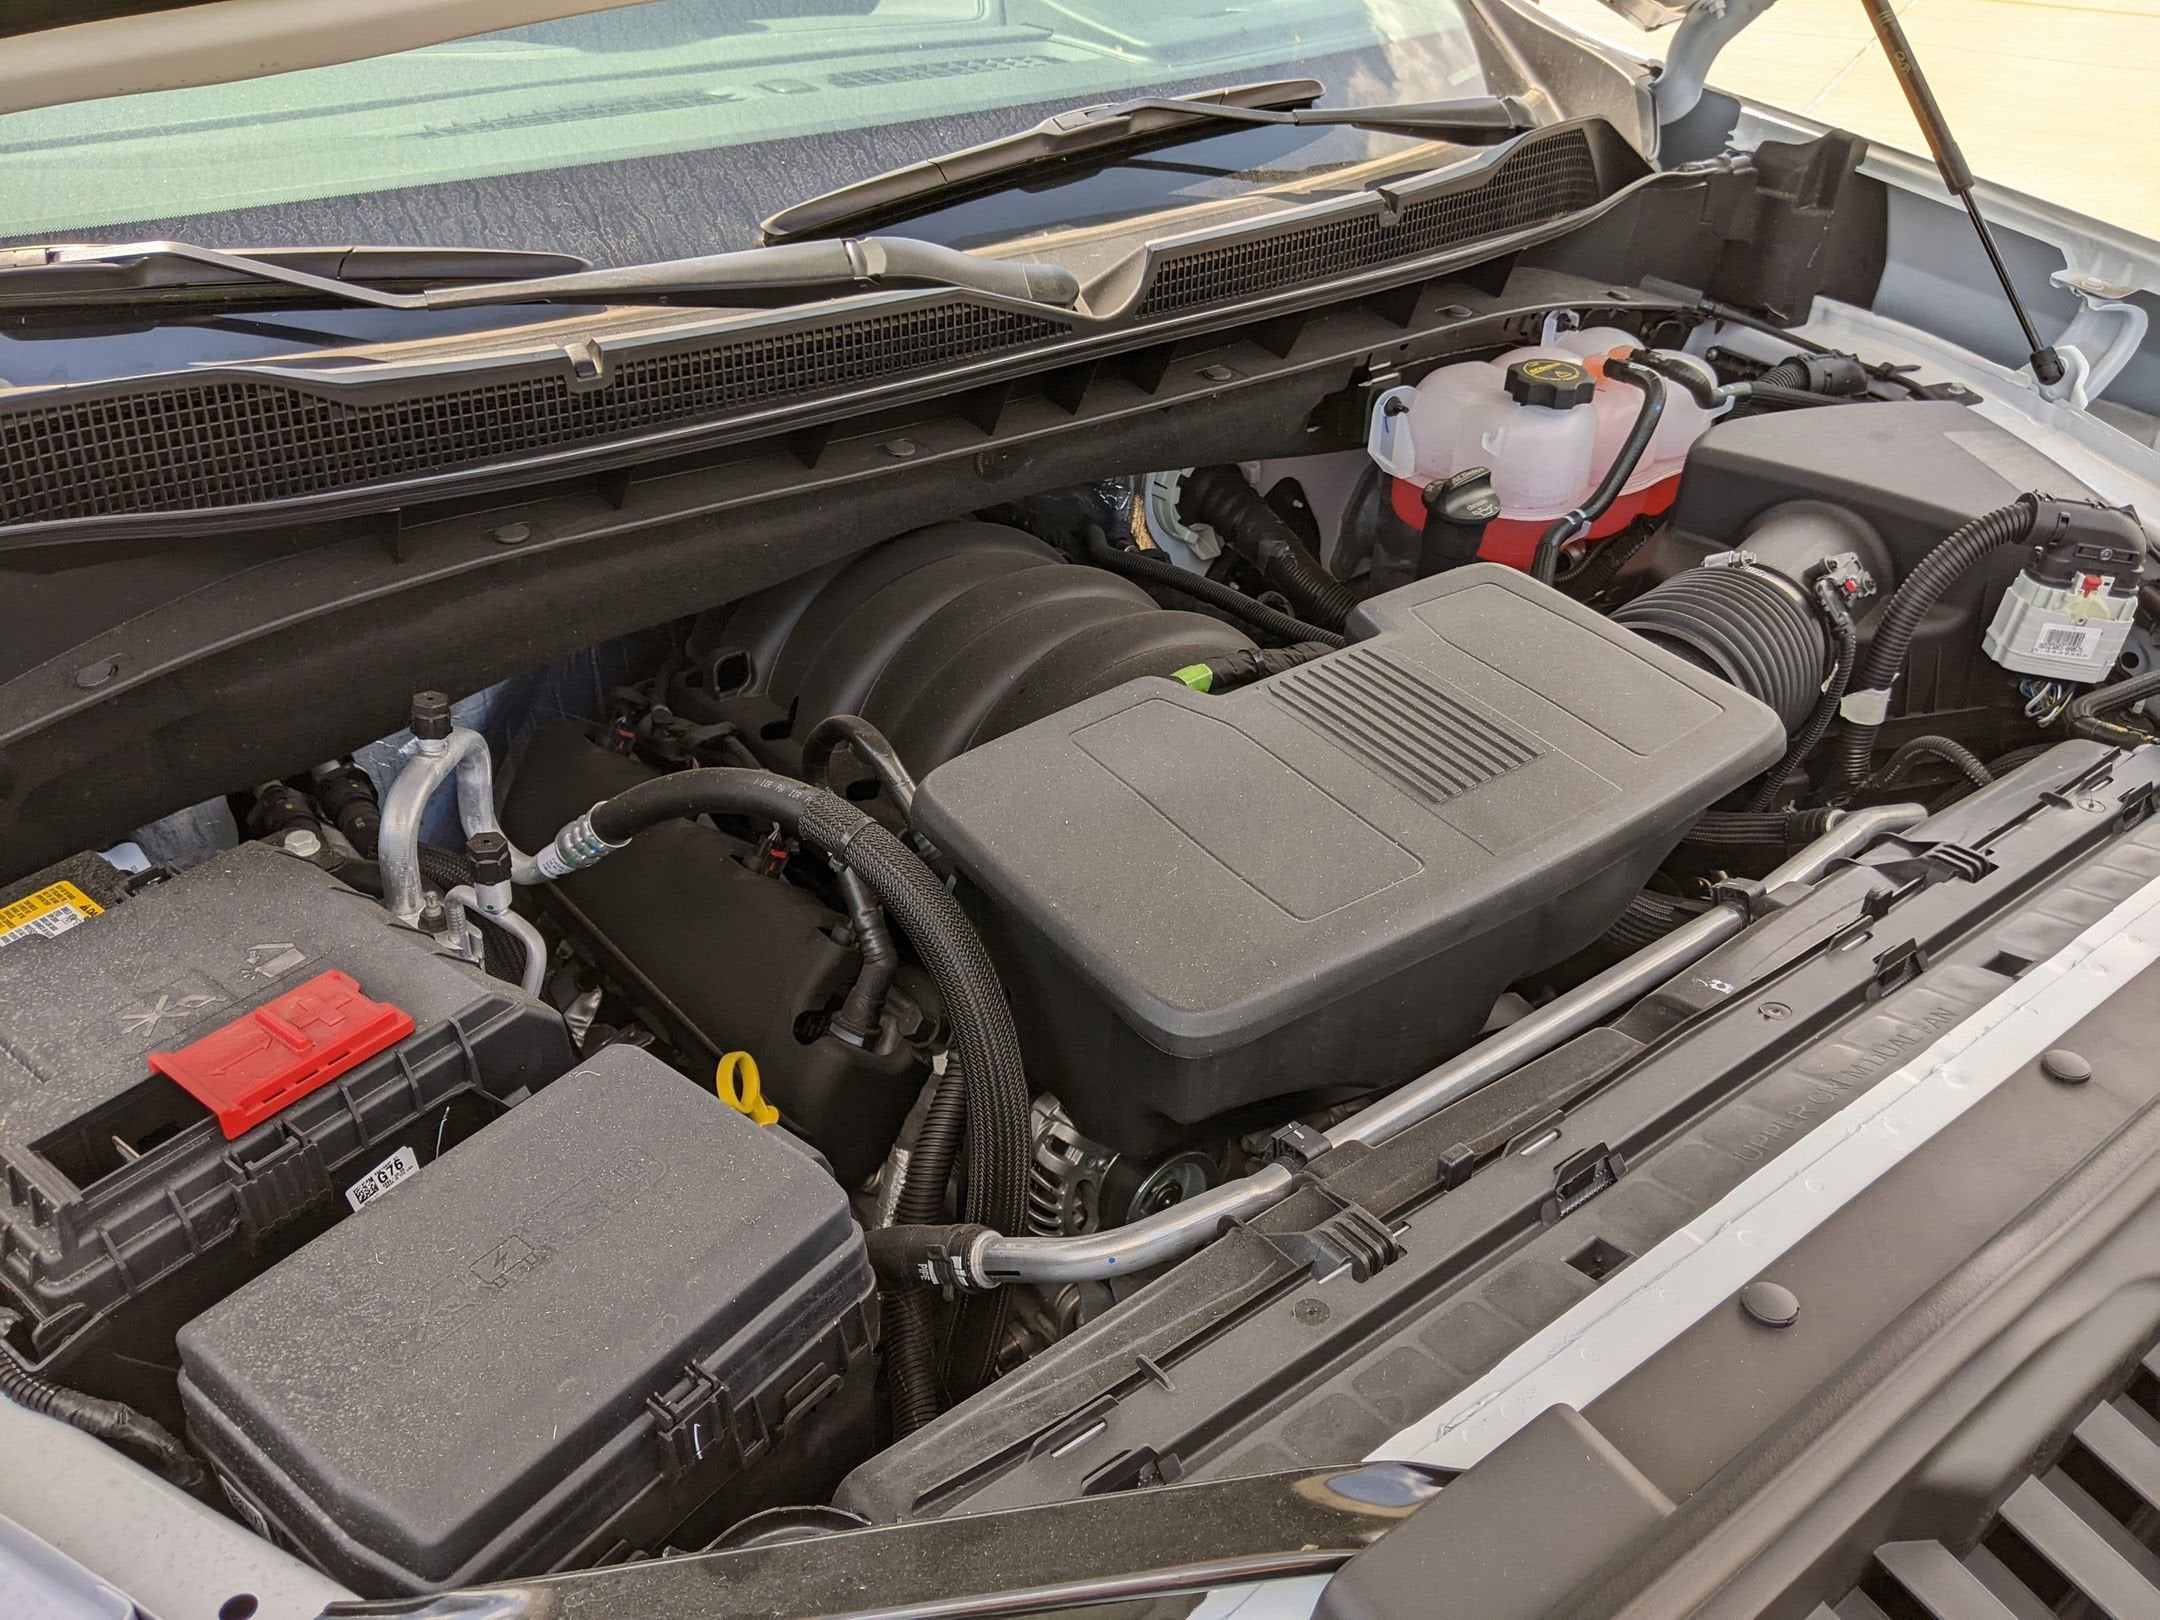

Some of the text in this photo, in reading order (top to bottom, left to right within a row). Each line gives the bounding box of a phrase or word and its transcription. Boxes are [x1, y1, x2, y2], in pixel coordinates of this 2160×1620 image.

[1914, 1007, 1958, 1035] FAN
[377, 1159, 403, 1184] G76
[918, 1263, 931, 1281] PIPE
